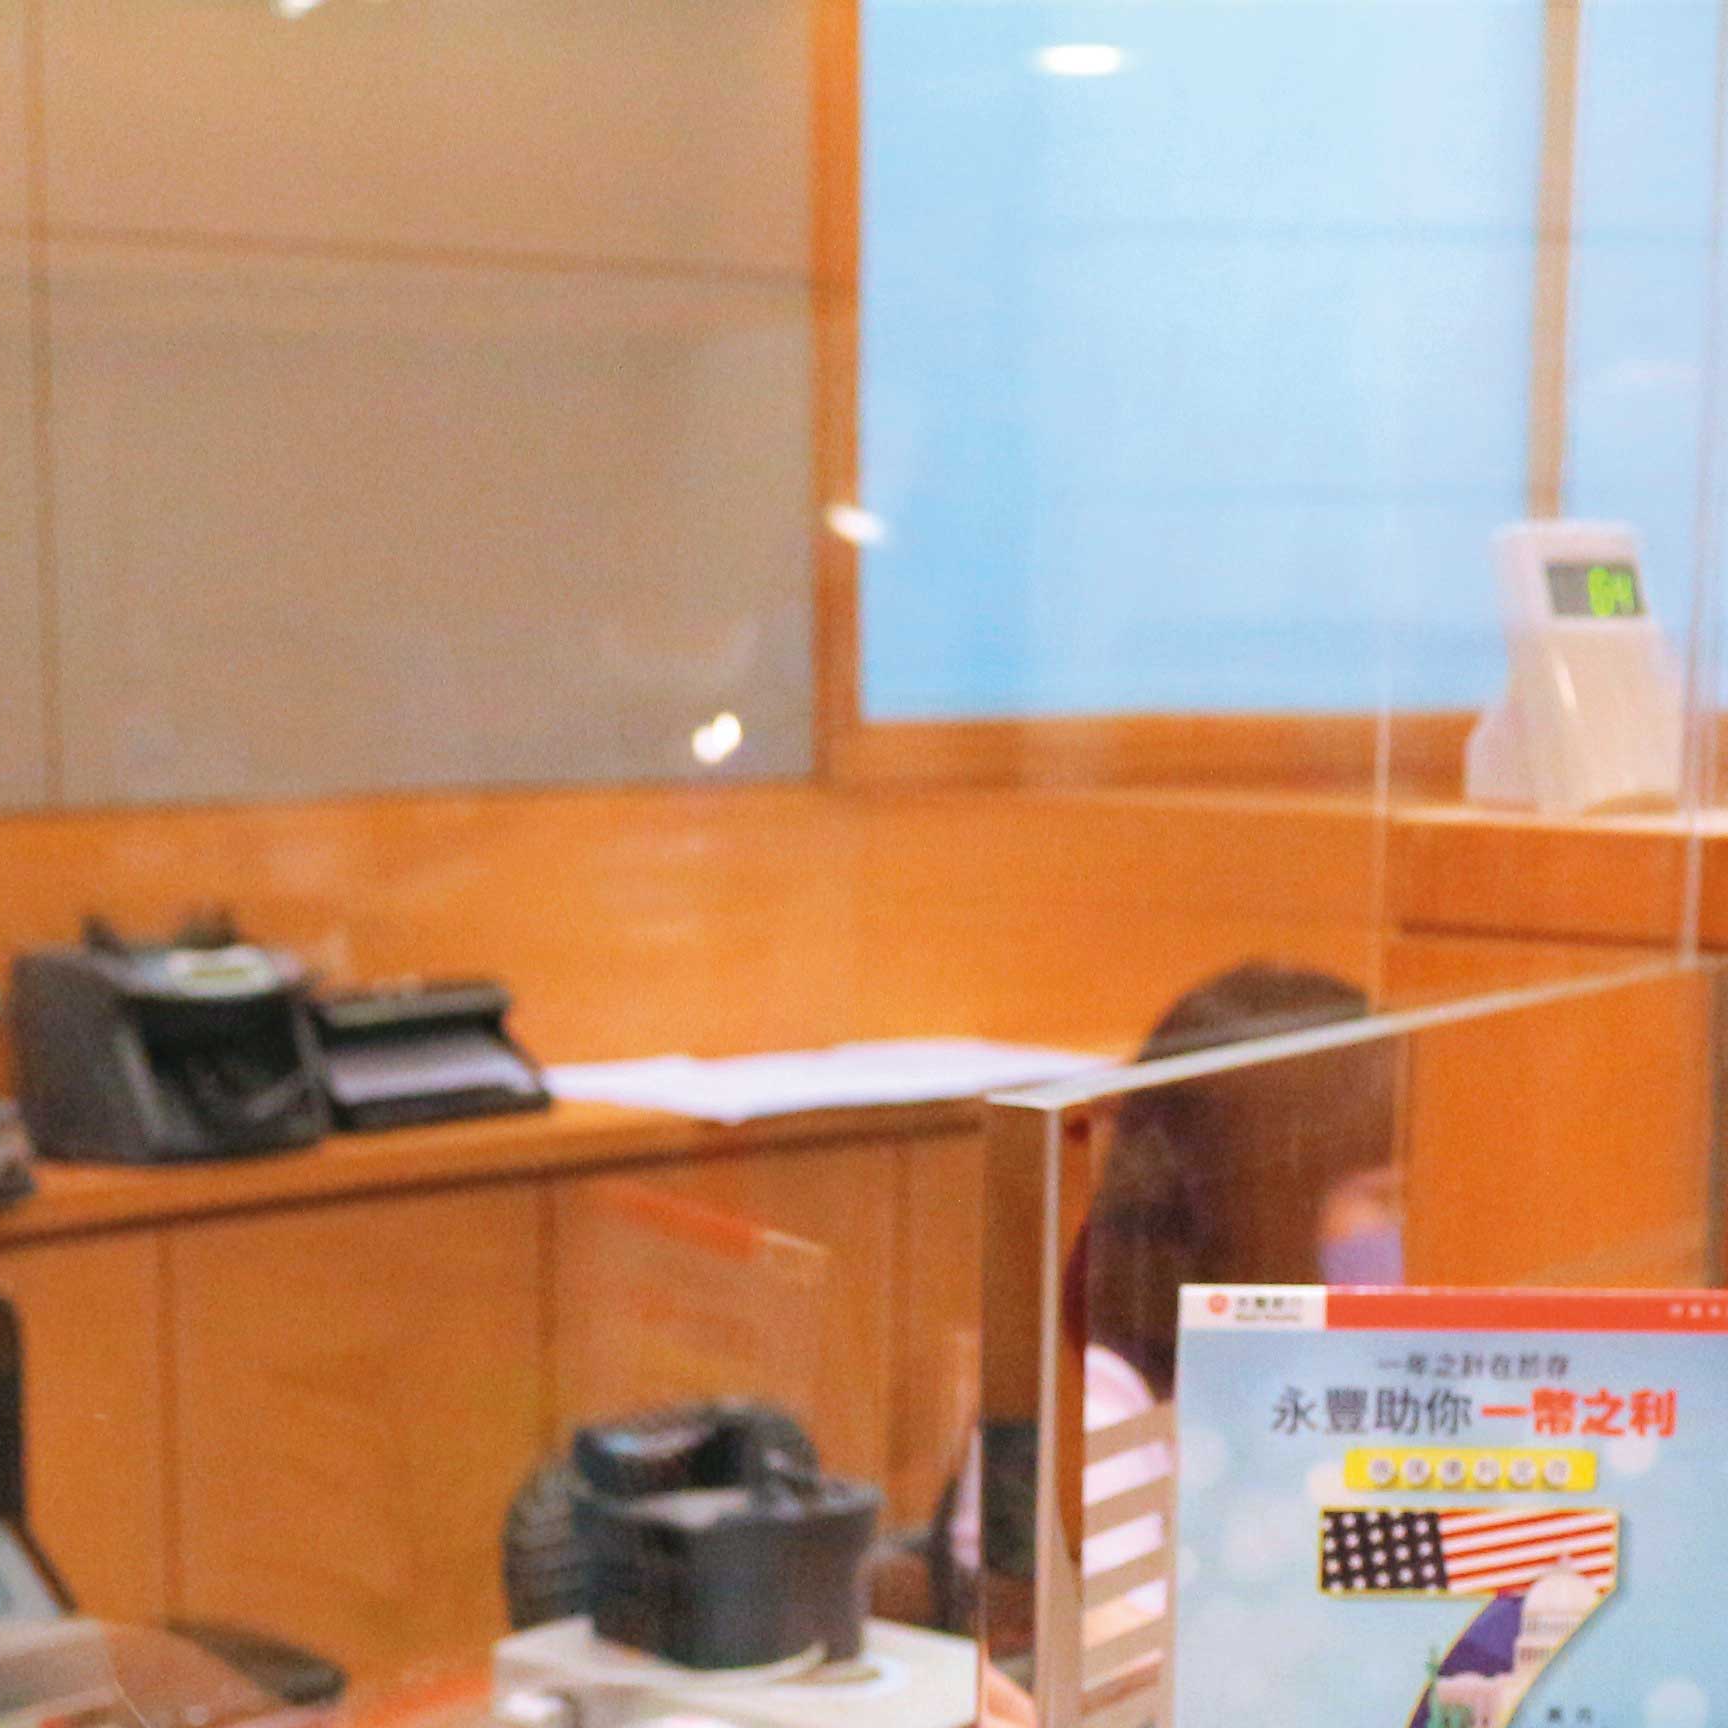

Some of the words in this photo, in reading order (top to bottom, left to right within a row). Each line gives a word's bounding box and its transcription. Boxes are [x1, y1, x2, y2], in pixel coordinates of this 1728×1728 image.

[1272, 1386, 1471, 1436] 永豐助你
[1480, 1387, 1678, 1437] 一幣之利
